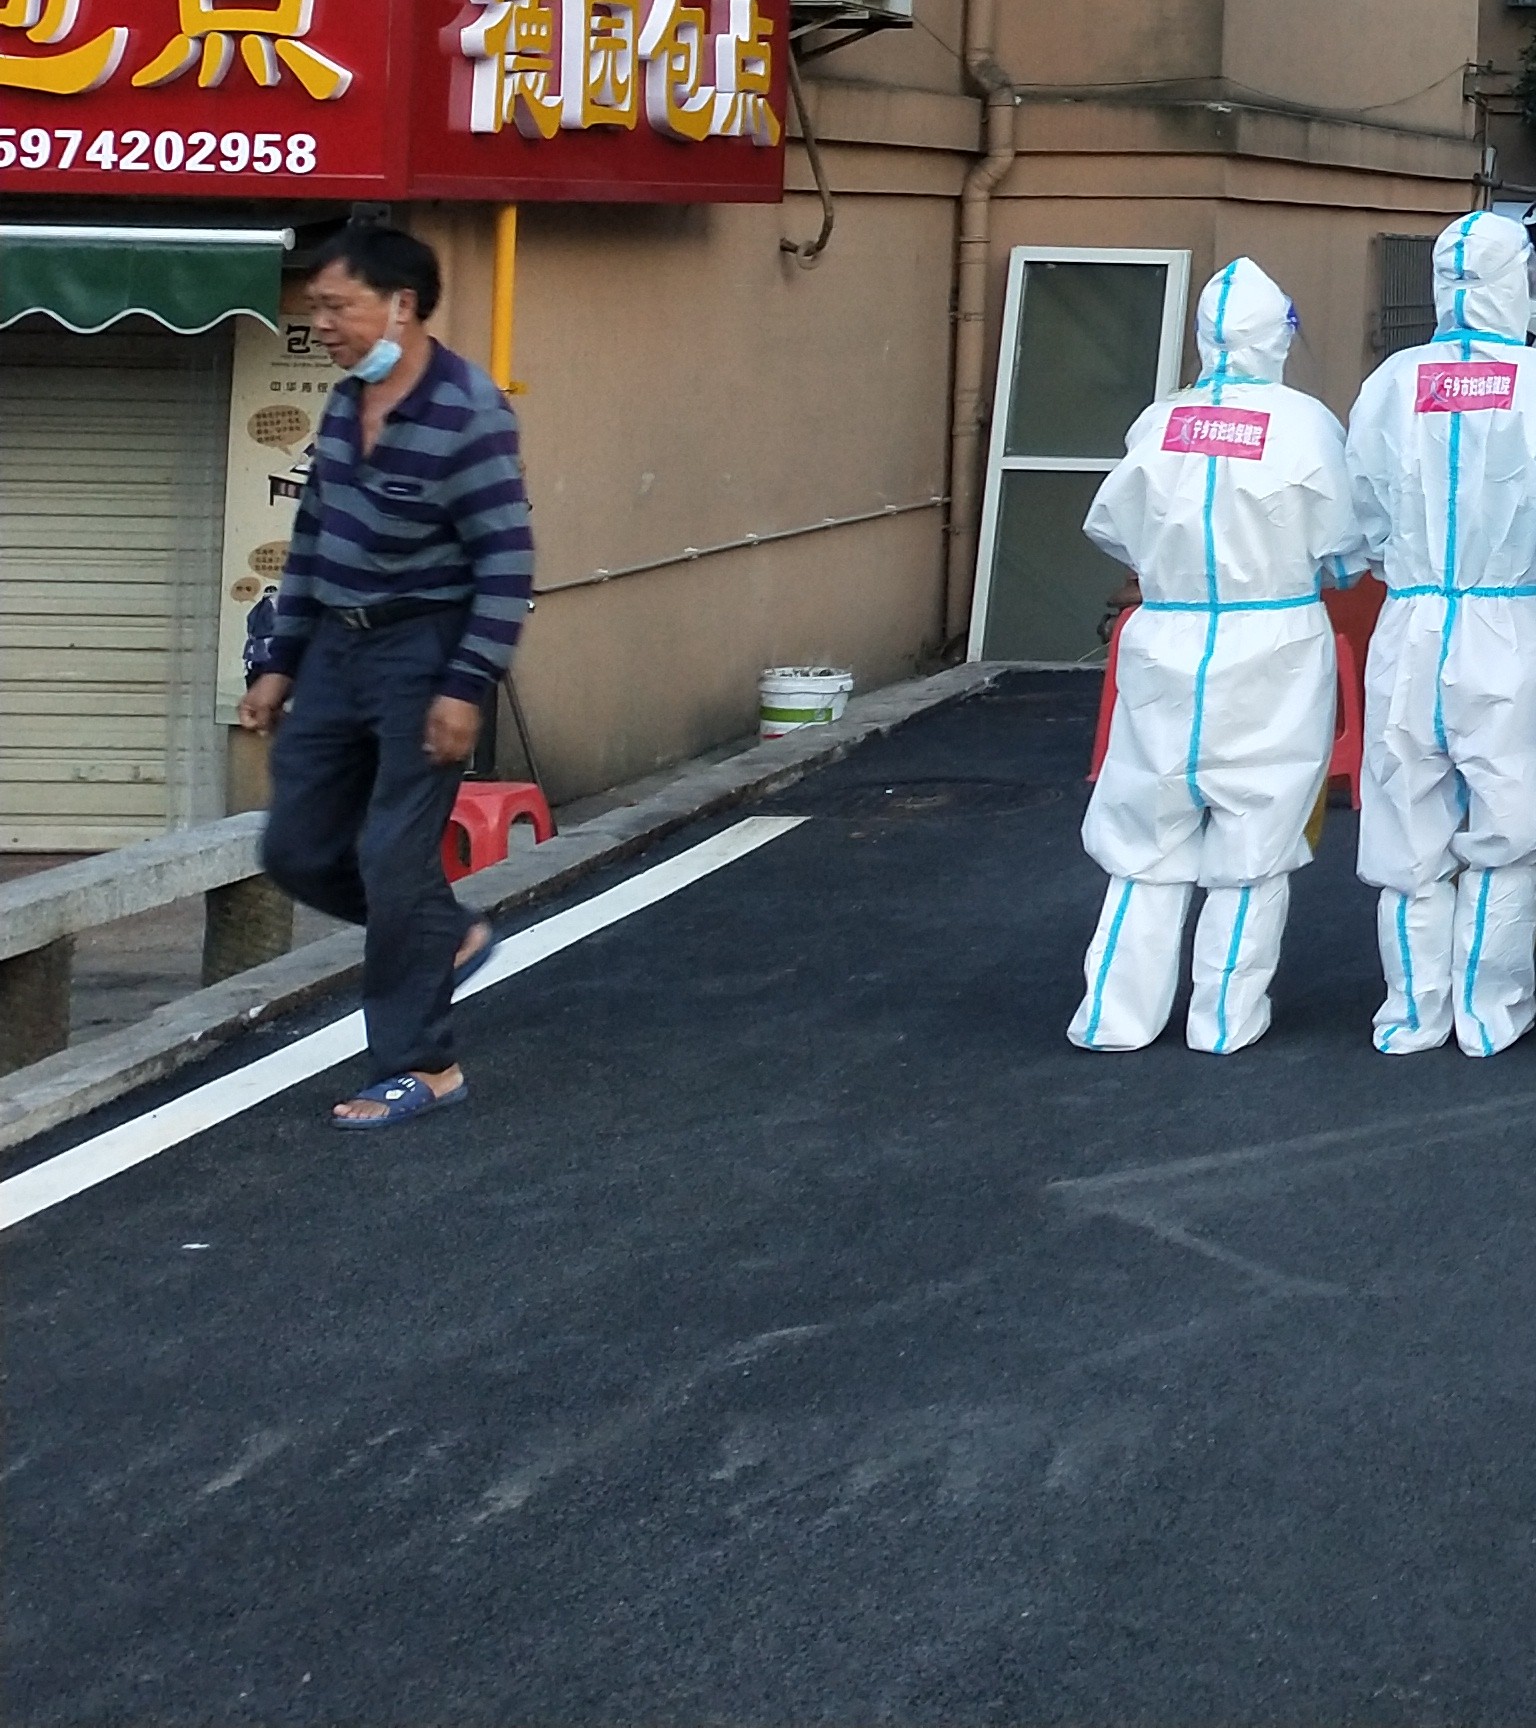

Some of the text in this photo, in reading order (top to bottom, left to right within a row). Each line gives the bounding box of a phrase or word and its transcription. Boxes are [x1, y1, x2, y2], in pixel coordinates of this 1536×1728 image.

[1444, 376, 1511, 397] 宁乡市妇幼保健院
[1193, 420, 1263, 446] 宁乡市妇幼保健院
